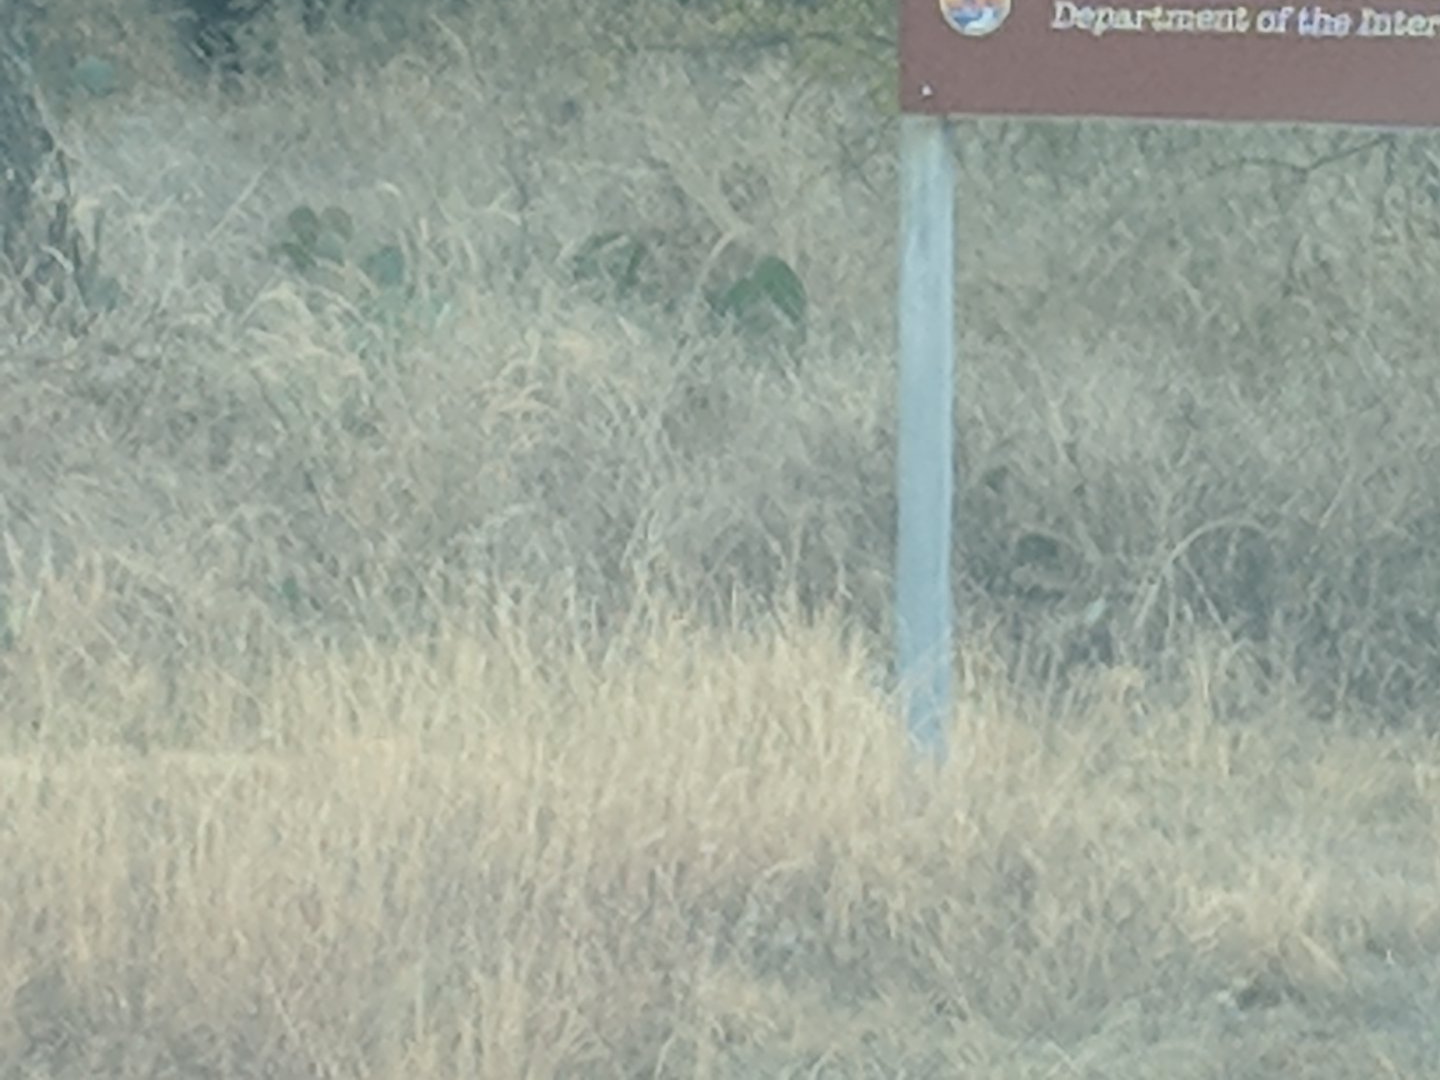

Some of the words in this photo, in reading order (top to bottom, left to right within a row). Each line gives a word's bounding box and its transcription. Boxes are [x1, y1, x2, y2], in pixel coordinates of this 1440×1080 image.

[1051, 0, 1250, 37] Department
[1256, 5, 1296, 34] of
[1297, 6, 1352, 38] the
